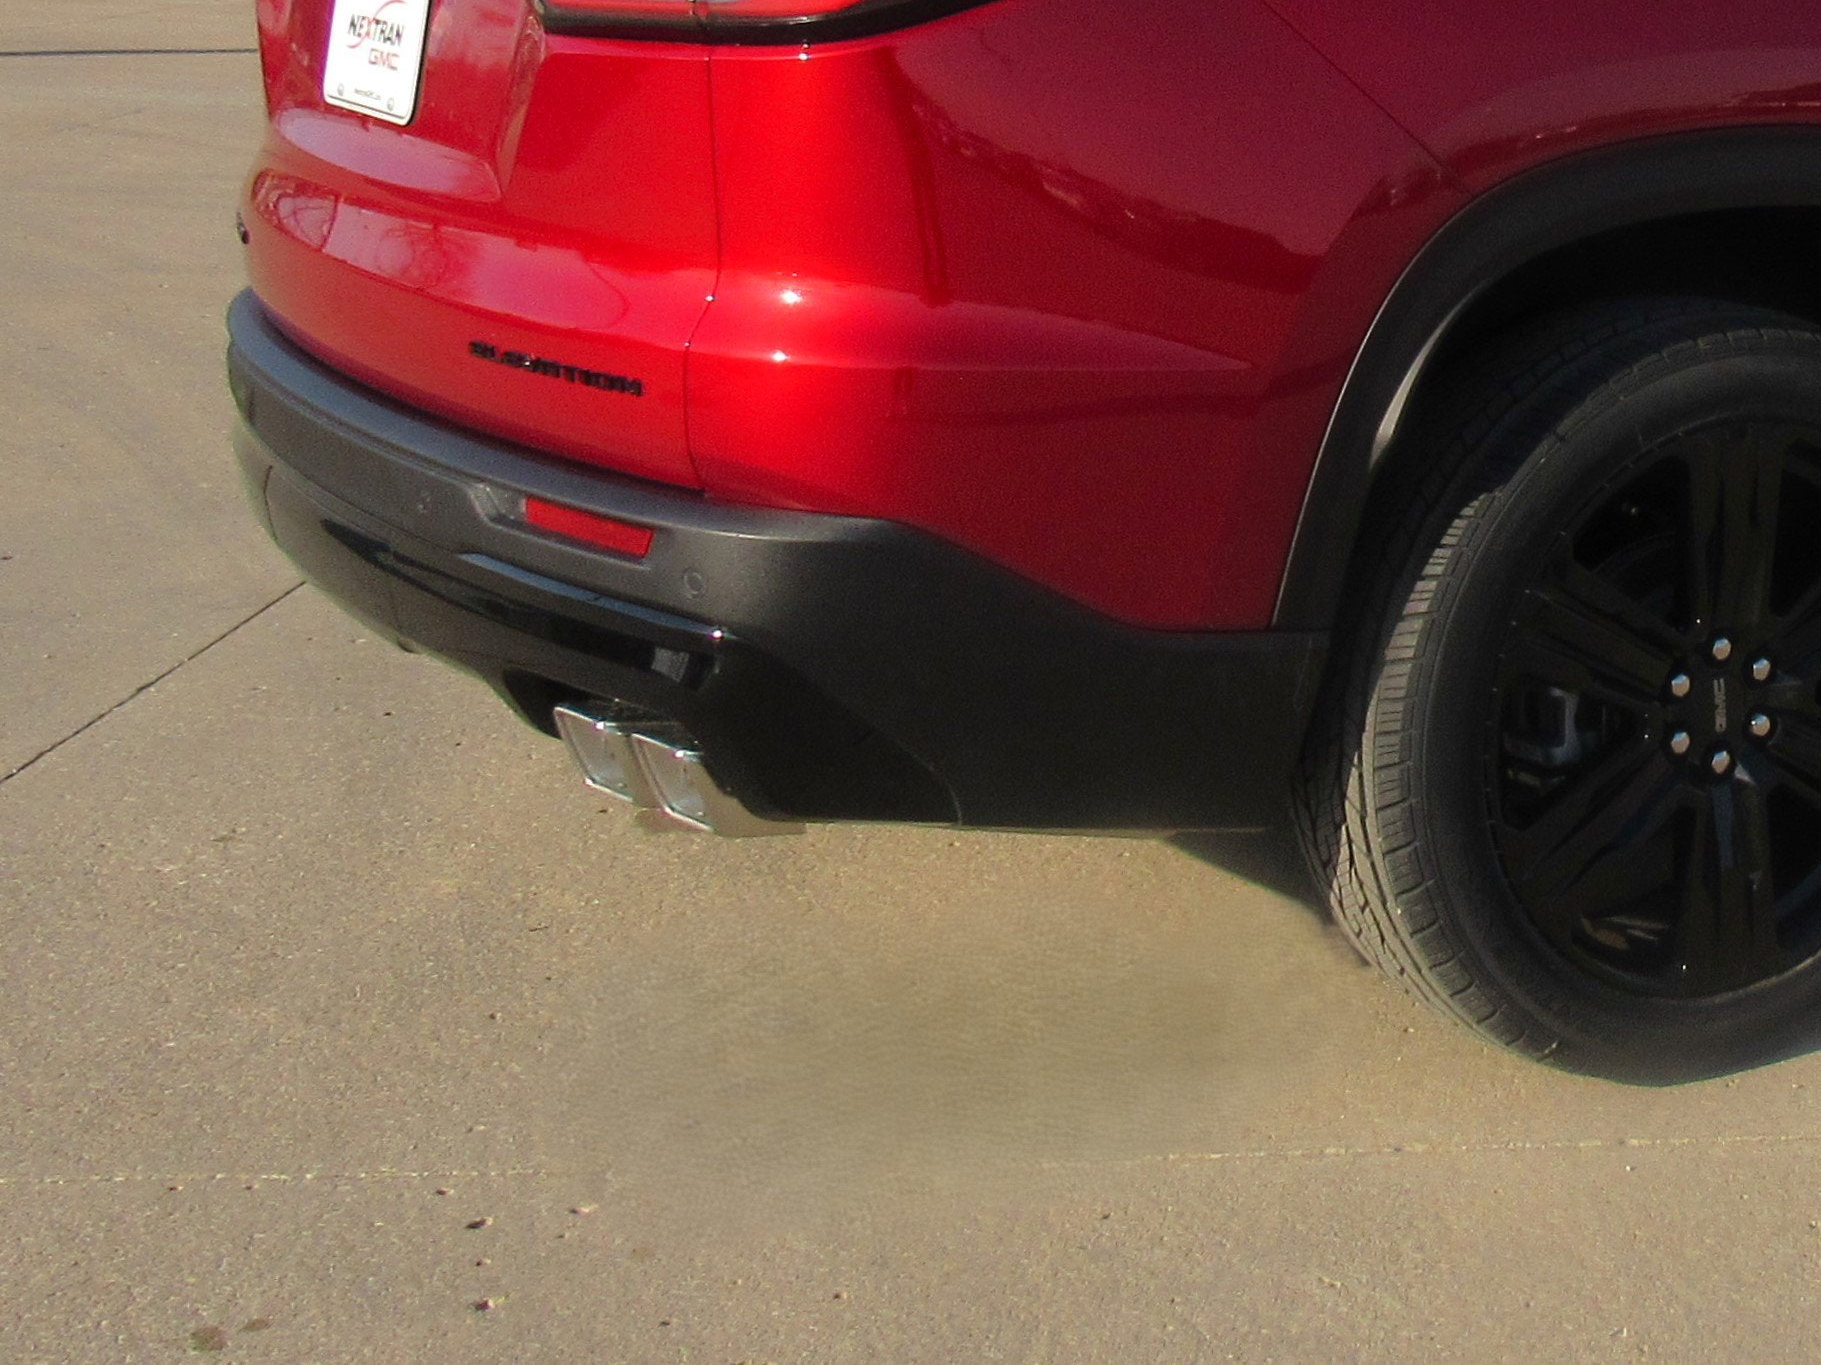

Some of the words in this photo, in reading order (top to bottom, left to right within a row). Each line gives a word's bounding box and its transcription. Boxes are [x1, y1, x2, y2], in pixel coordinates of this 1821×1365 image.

[347, 13, 404, 47] NEXTRAN
[368, 48, 400, 71] GMC
[1713, 678, 1727, 732] GMC
